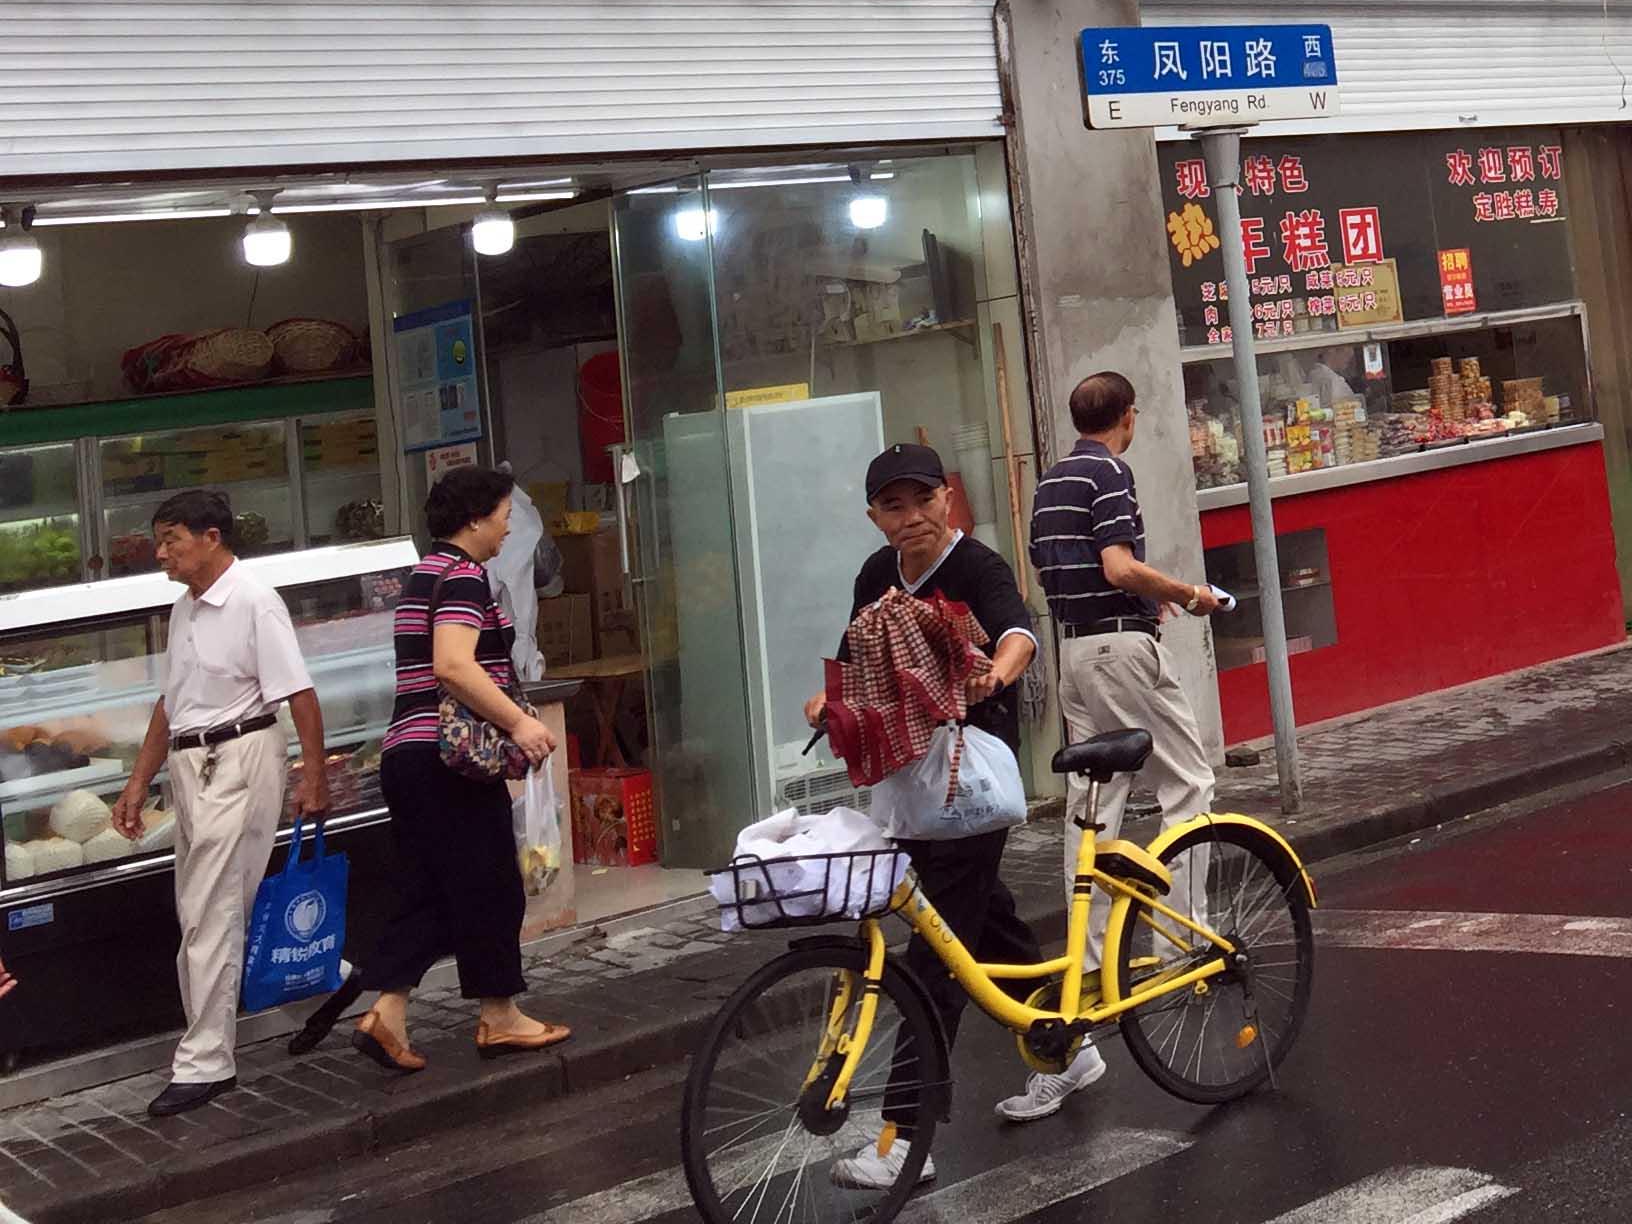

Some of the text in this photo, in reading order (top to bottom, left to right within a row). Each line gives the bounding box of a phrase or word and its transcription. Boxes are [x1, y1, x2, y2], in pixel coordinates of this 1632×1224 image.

[1099, 40, 1120, 65] 东
[1302, 35, 1321, 58] 西
[1153, 38, 1277, 81] 凤阳路
[1099, 69, 1125, 86] 375
[1108, 101, 1123, 120] E
[1170, 97, 1239, 115] Fengyang
[1309, 92, 1327, 110] W
[1175, 155, 1309, 199] 现特色
[1447, 145, 1563, 186] 欢迎预订
